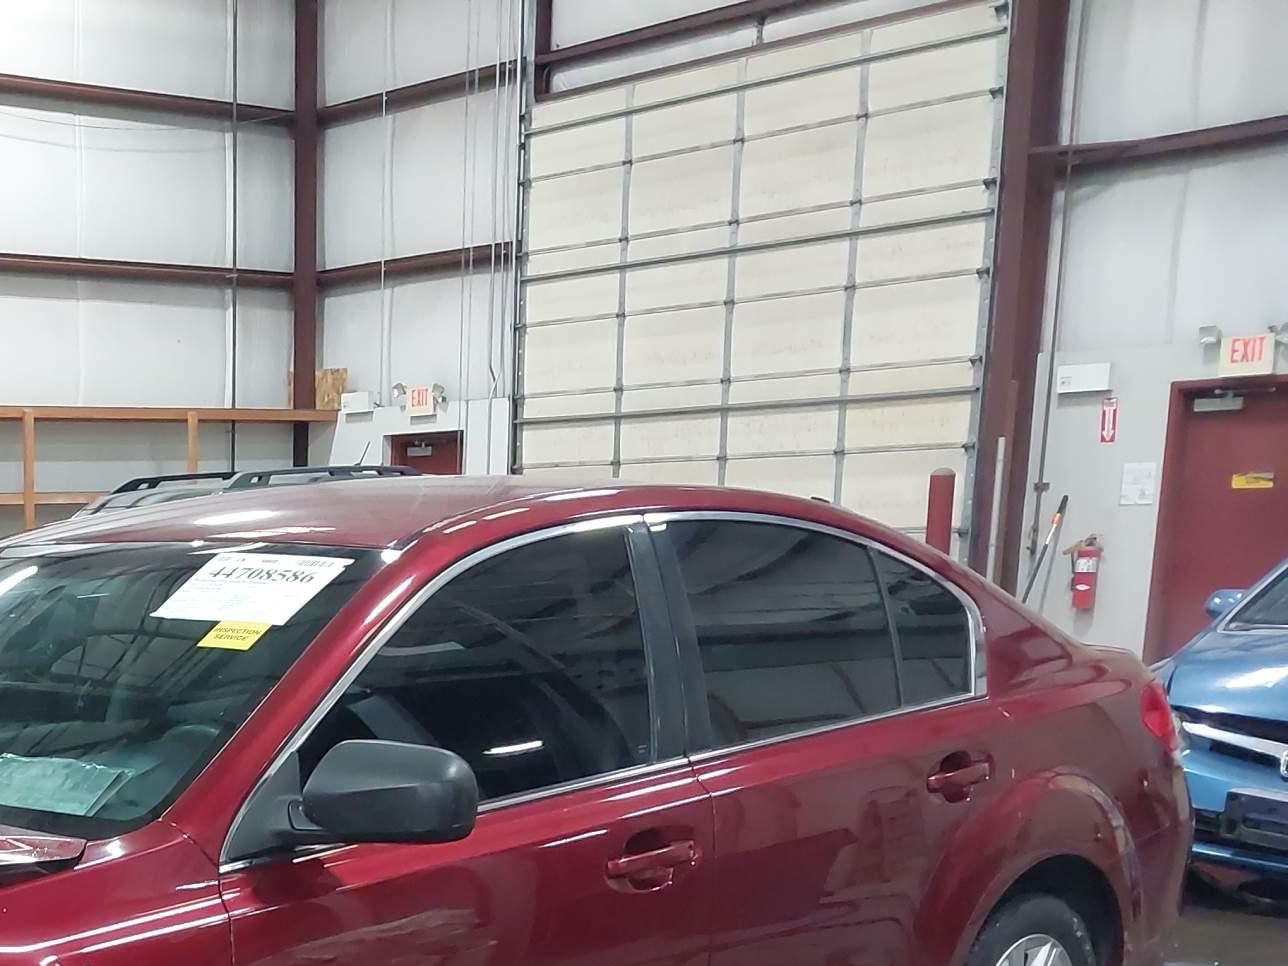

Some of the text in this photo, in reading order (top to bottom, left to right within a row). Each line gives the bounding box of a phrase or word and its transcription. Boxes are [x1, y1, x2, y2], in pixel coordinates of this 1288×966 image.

[1230, 335, 1267, 364] EXIT
[411, 388, 430, 407] EXIT
[209, 566, 316, 583] 44708586
[212, 627, 263, 636] INSPECTION
[213, 633, 249, 642] SERVICE
